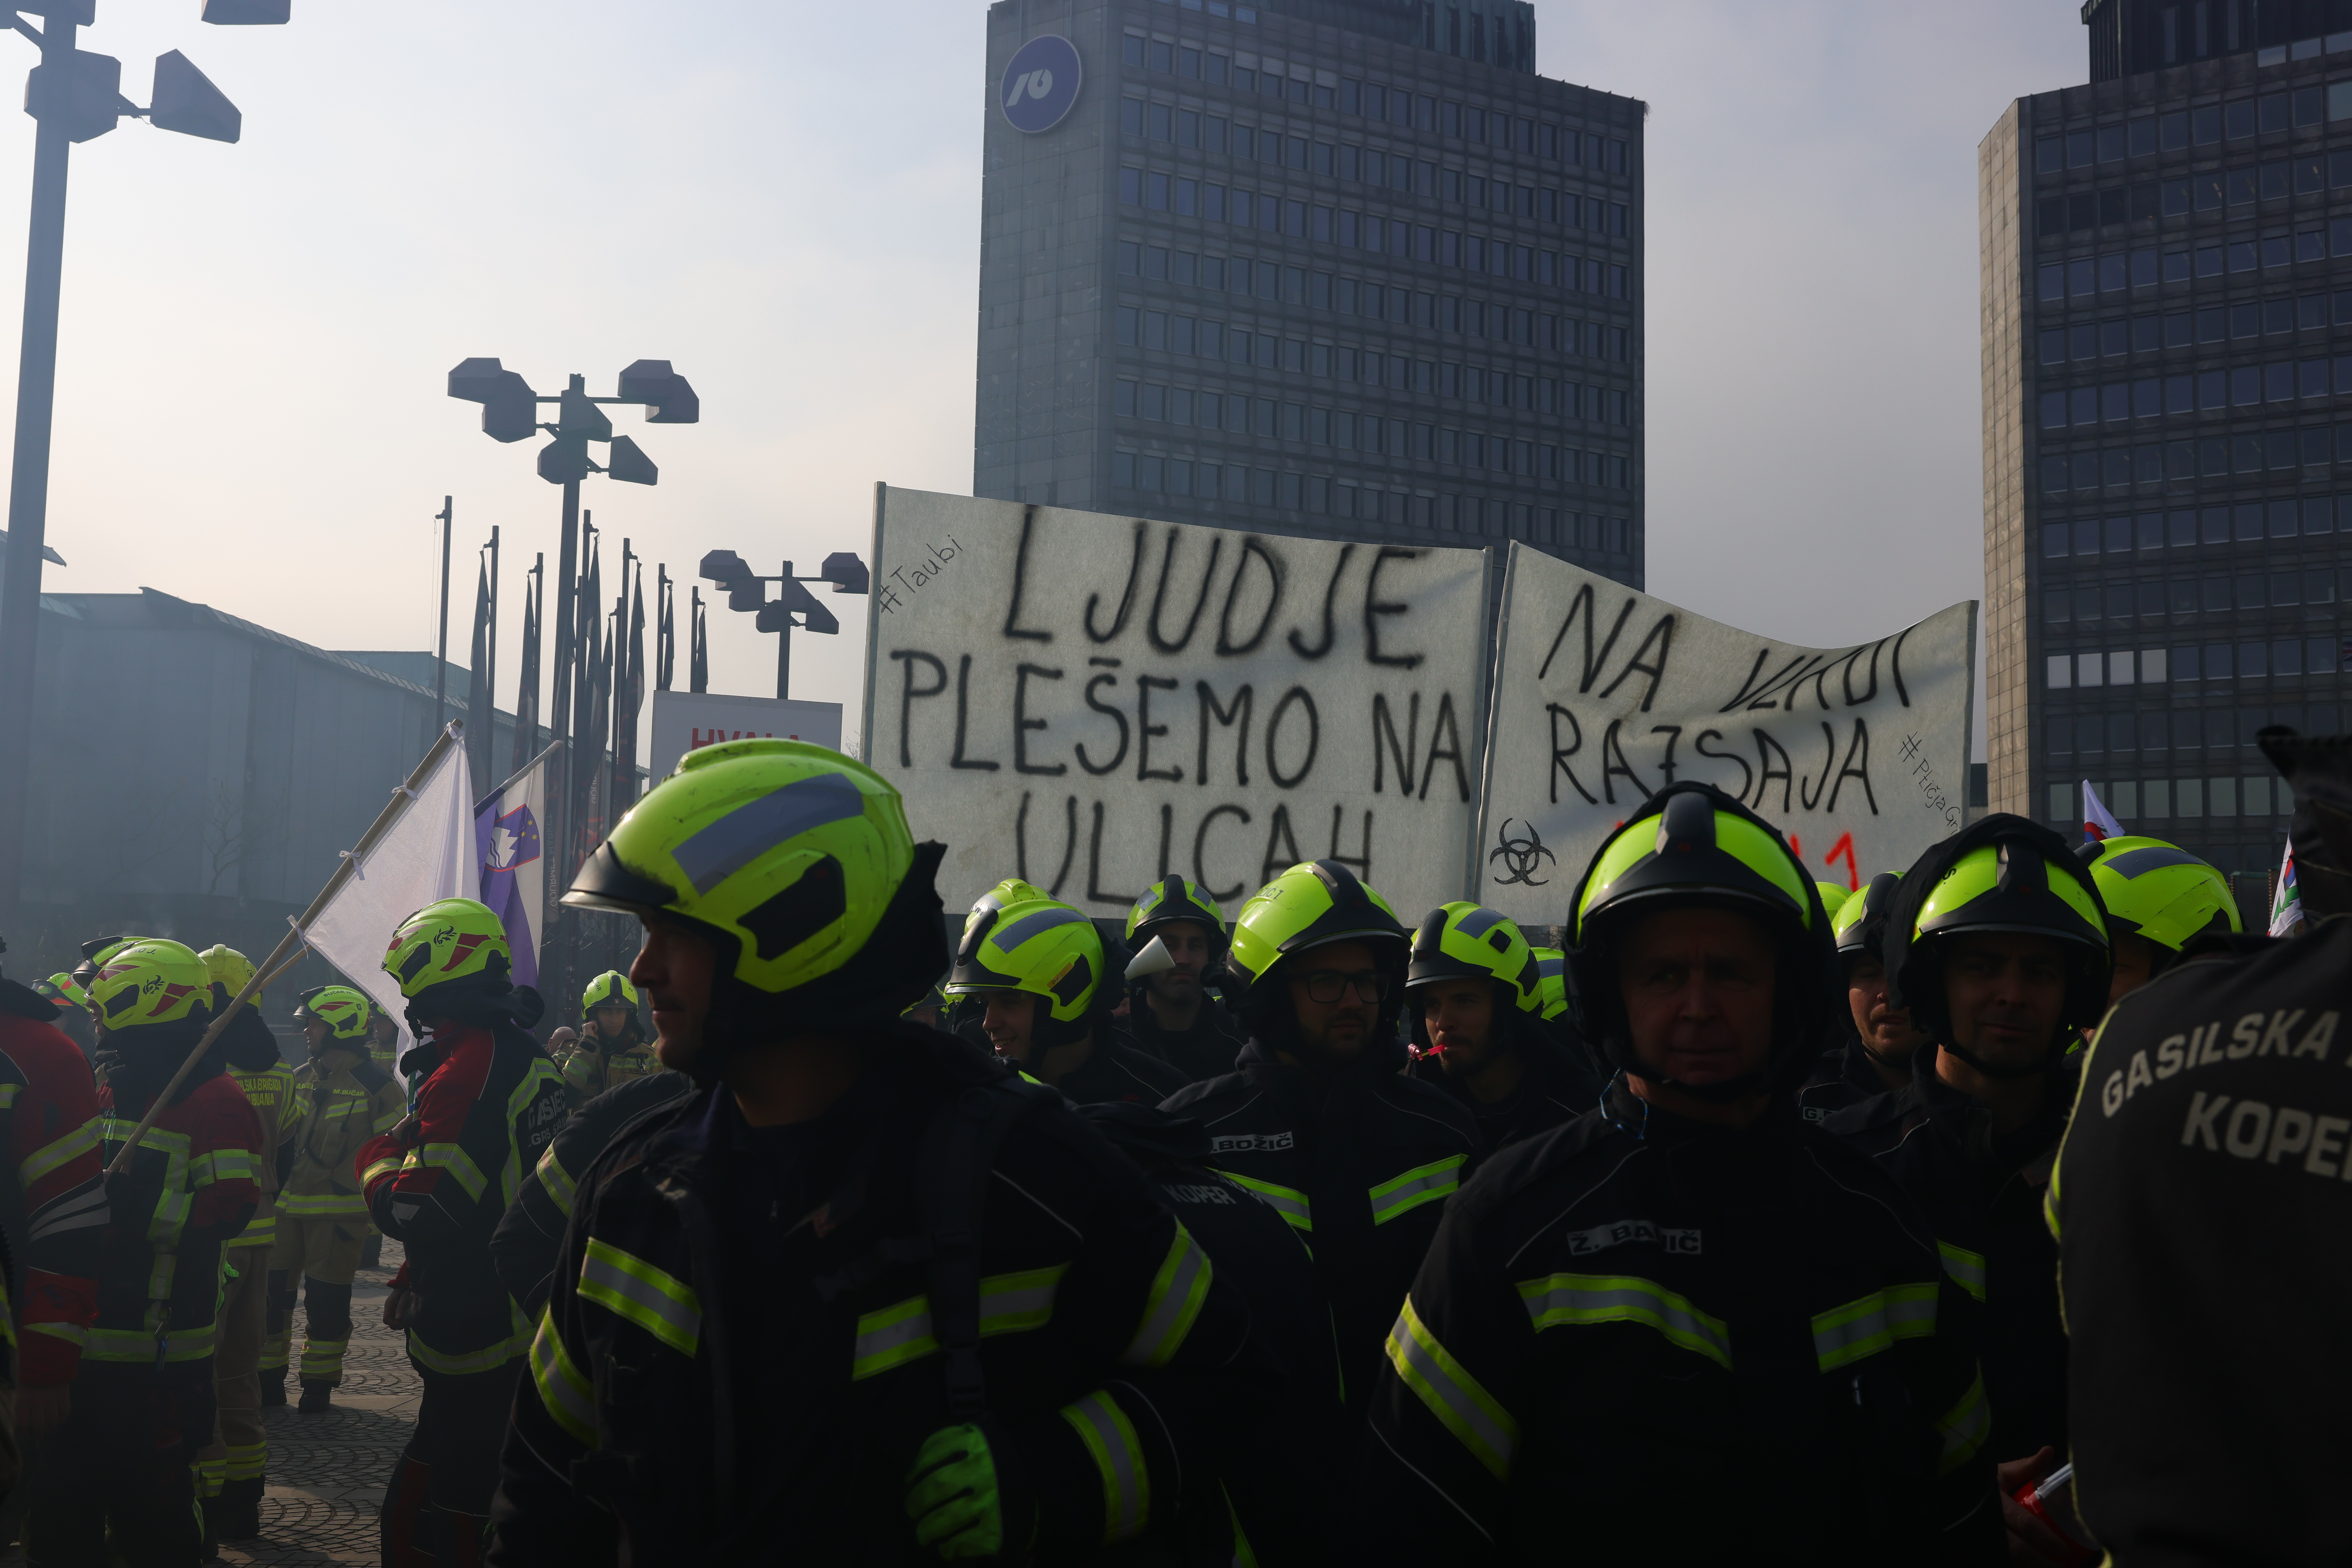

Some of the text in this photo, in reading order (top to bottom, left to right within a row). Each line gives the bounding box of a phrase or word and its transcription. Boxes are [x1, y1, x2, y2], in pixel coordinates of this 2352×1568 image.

[880, 534, 963, 614] #Taubi
[1003, 505, 1425, 669] LJUDJE
[1538, 583, 1677, 713] NA
[890, 650, 1471, 803] PLEŠEMO NA
[1016, 790, 1373, 907] ULICAH
[2102, 1008, 2341, 1119] GASILSKA
[2180, 1091, 2352, 1182] KOPE
[1160, 1184, 1237, 1205] KOPER
